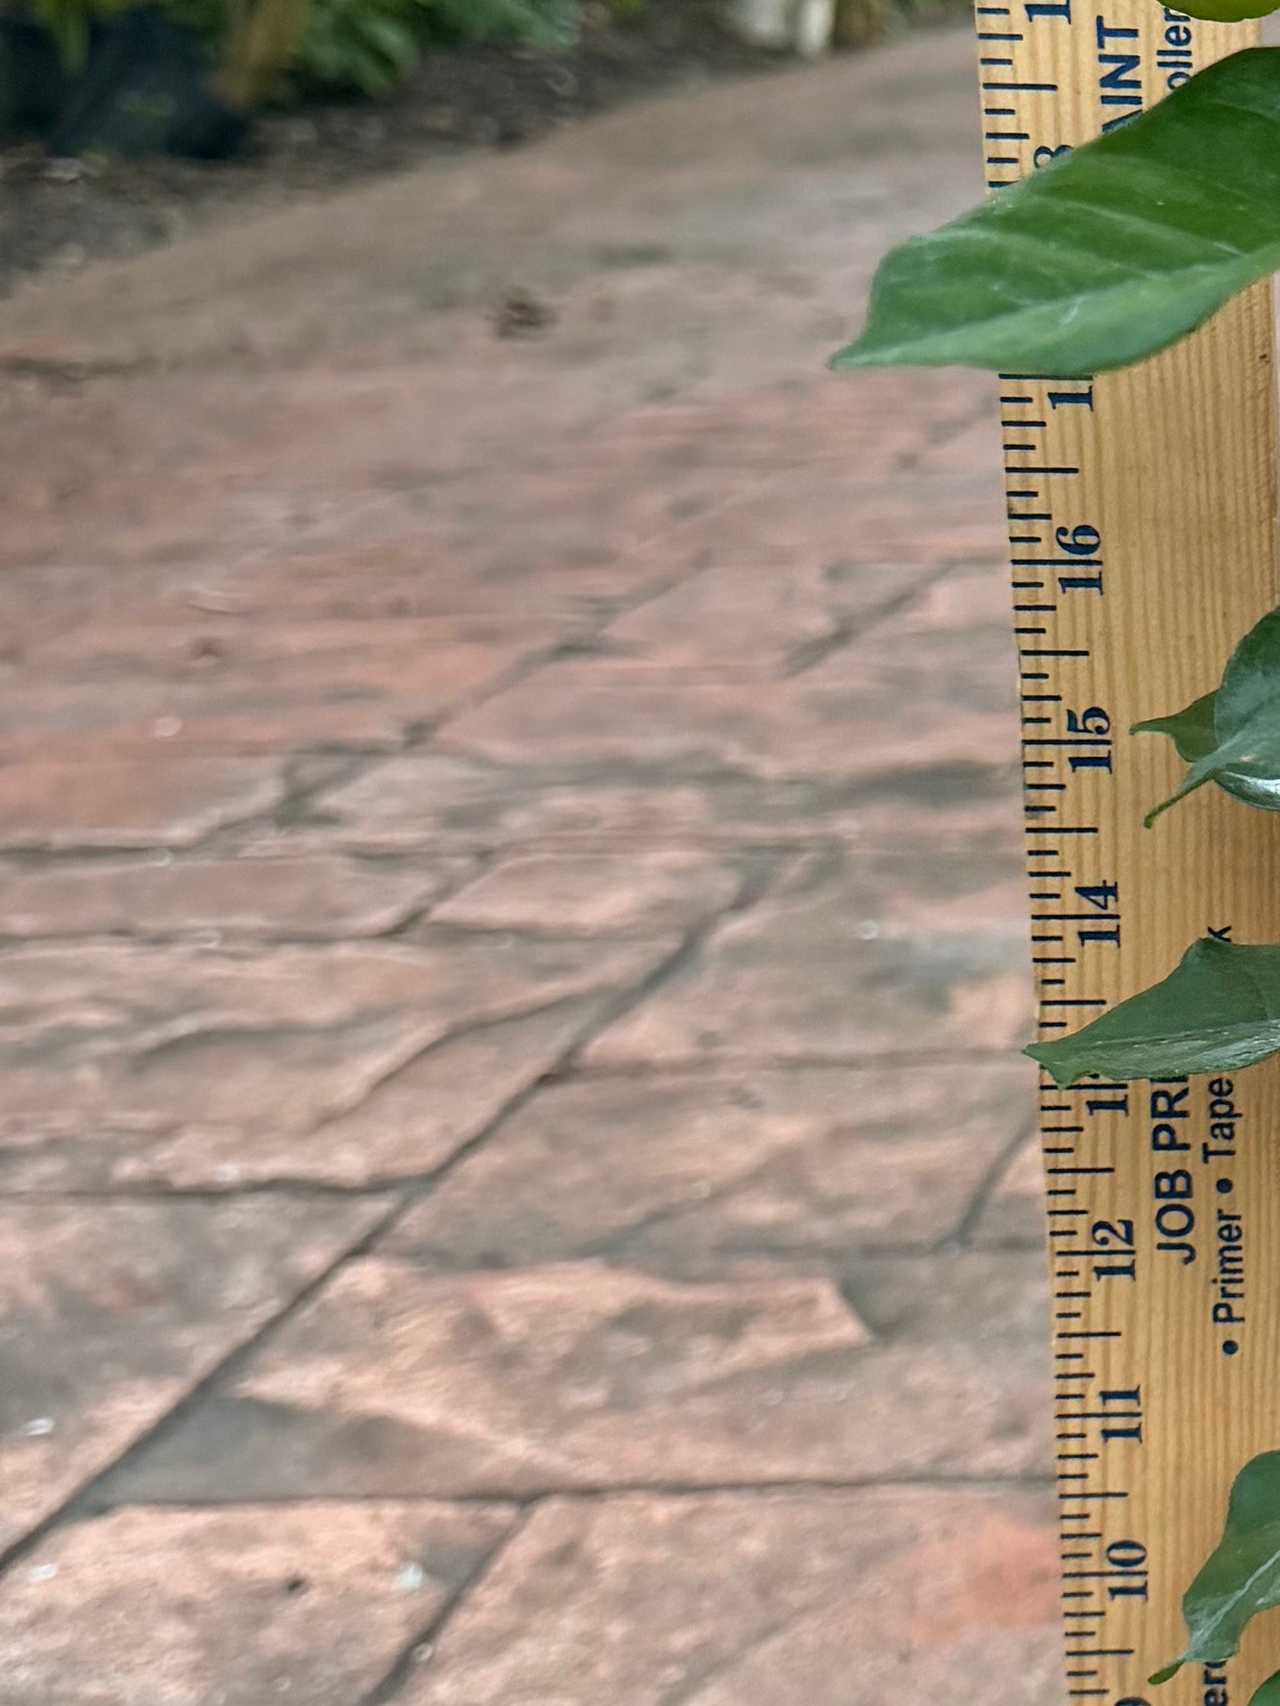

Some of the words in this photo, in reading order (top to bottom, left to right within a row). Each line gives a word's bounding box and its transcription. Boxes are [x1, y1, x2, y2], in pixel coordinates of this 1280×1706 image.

[1096, 15, 1142, 132] INT
[1156, 7, 1193, 90] oller
[1047, 385, 1094, 412] 1
[1055, 524, 1104, 596] 16
[1066, 706, 1113, 775] 15
[1074, 879, 1121, 949] 14
[1149, 1076, 1192, 1151] PR
[1202, 1077, 1244, 1164] Tape
[1091, 1219, 1137, 1282] 12
[1154, 1169, 1196, 1265] JOB
[1212, 1209, 1246, 1325] Primer
[1099, 1385, 1143, 1444] 11
[1105, 1539, 1149, 1603] 10
